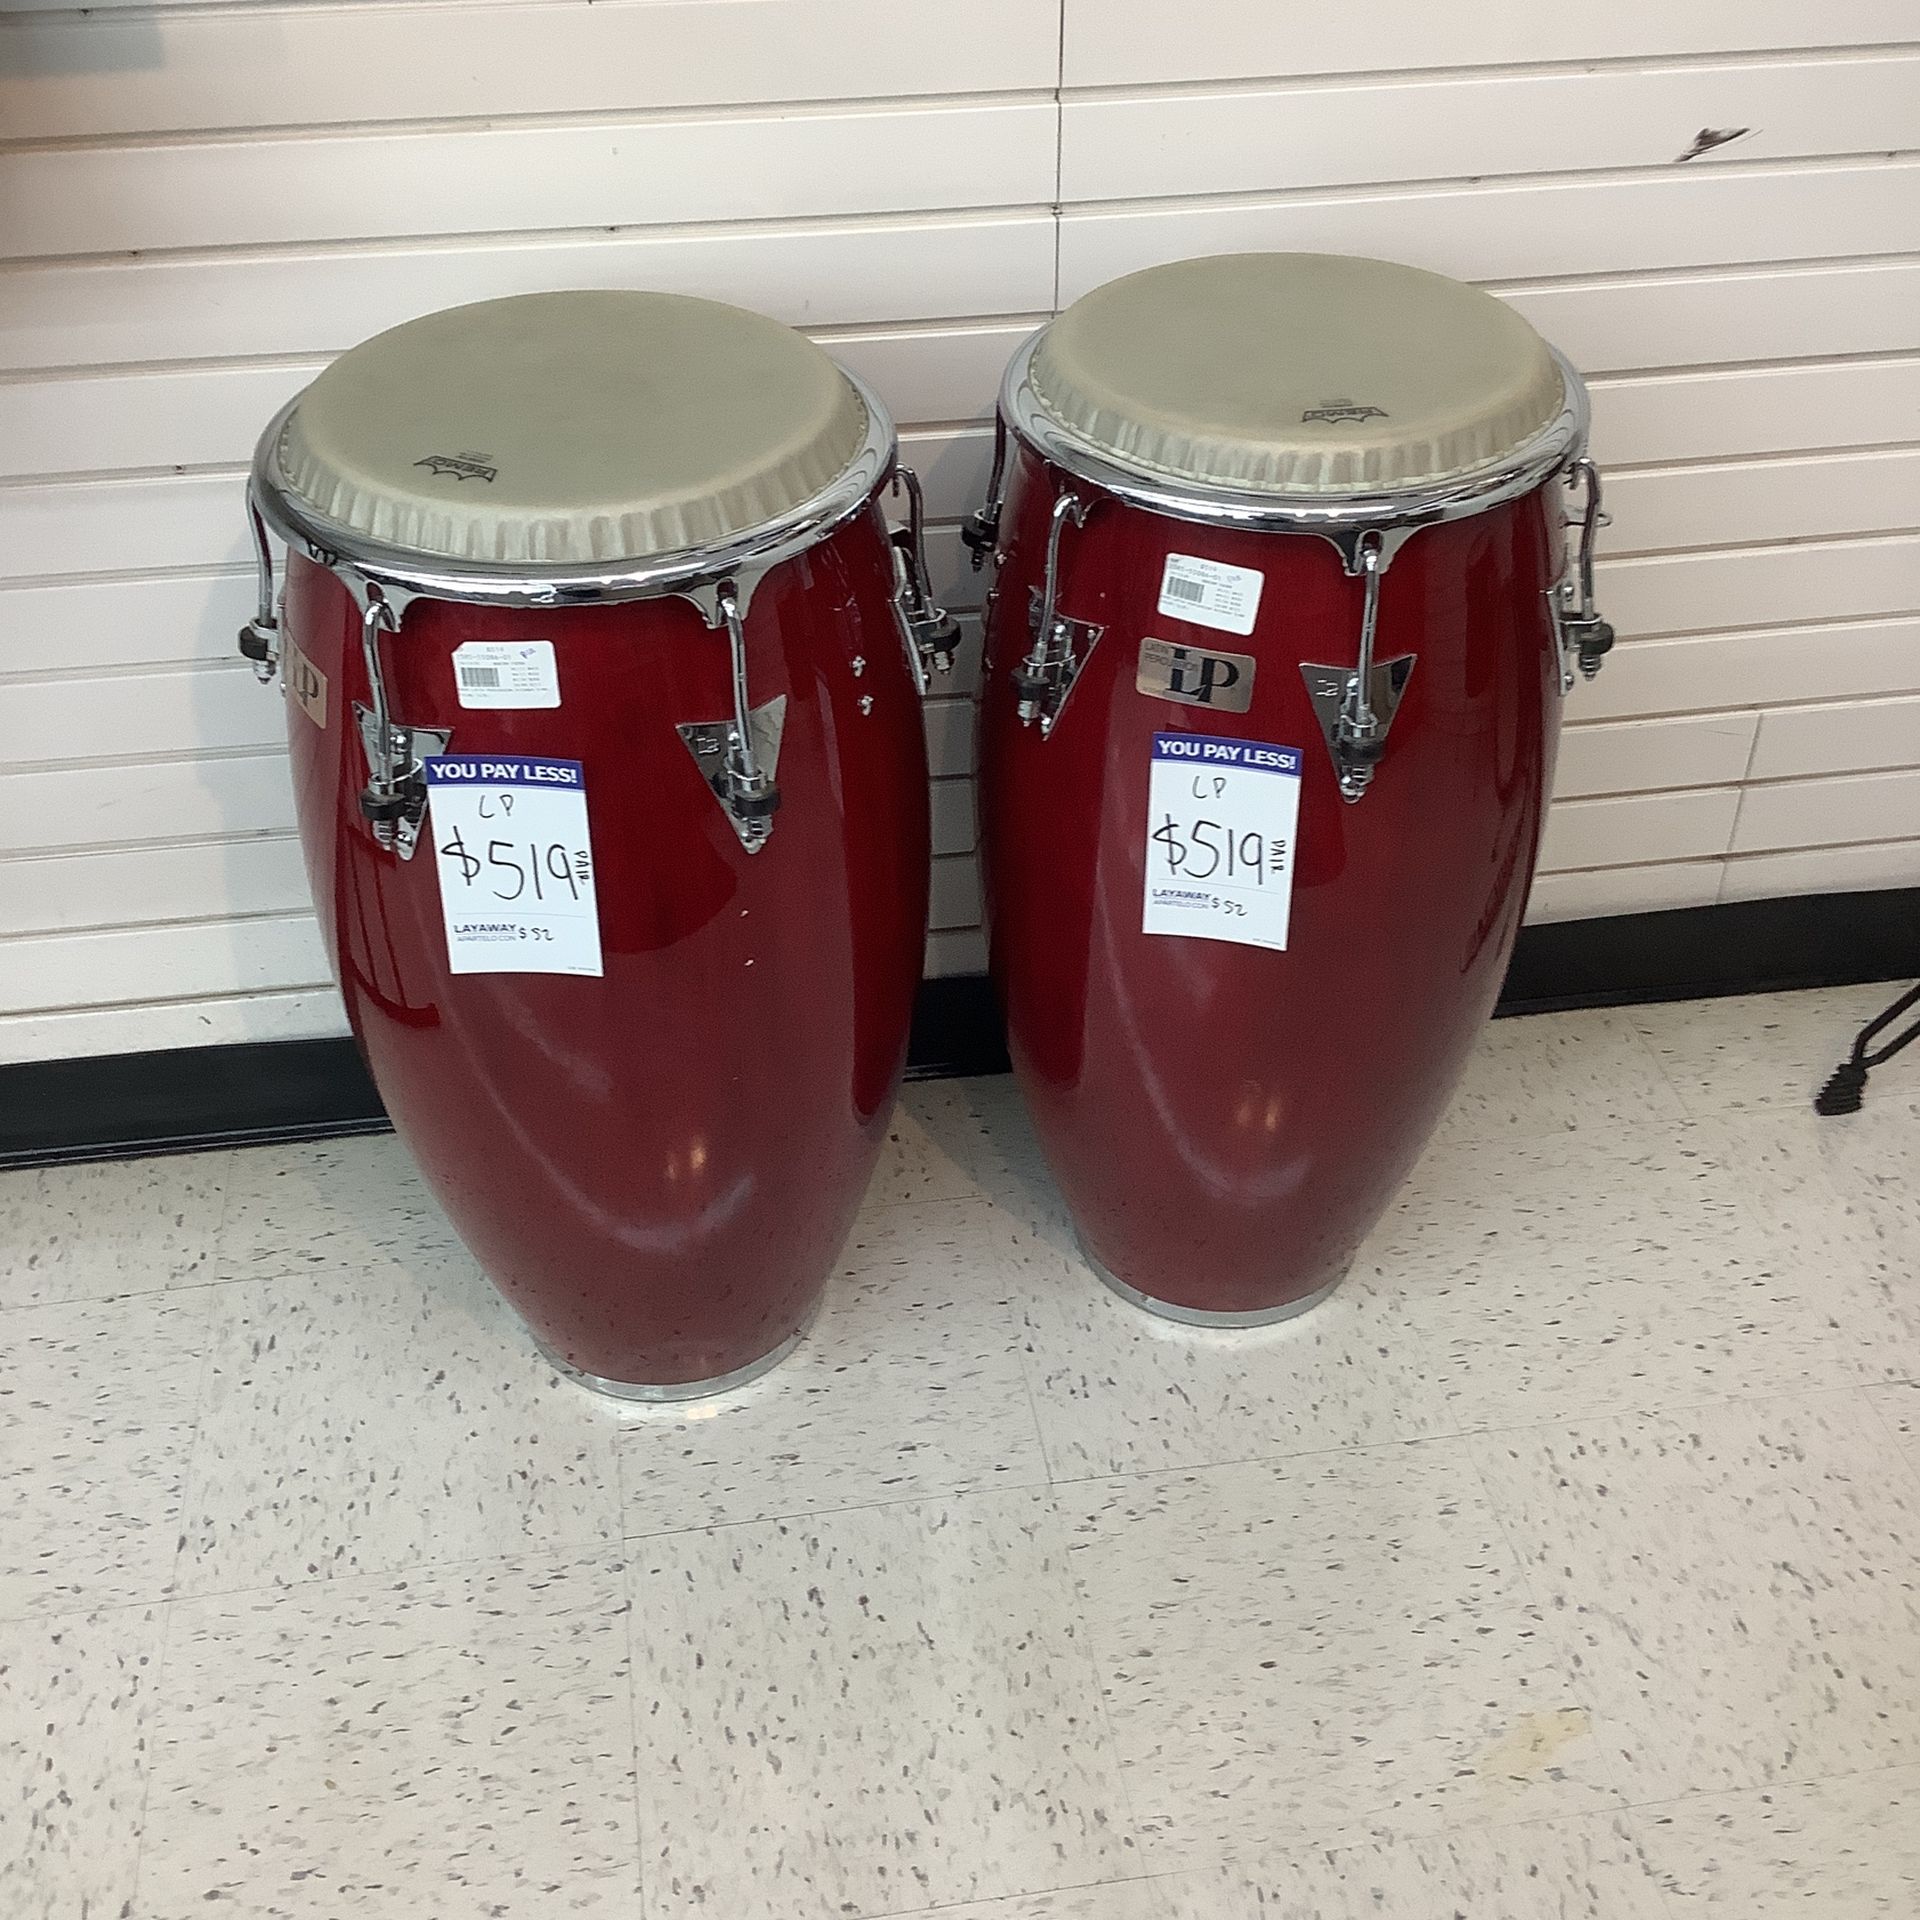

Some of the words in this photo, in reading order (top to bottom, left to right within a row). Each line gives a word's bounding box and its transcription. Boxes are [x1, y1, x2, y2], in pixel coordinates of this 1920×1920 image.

[1165, 646, 1239, 704] LP
[1158, 740, 1200, 757] YOU
[1203, 743, 1241, 761] PAY
[1244, 749, 1296, 769] LESS!
[431, 764, 477, 779] YOU
[481, 764, 520, 779] PAY
[523, 765, 577, 783] LESS!
[1192, 776, 1227, 799] LP
[479, 794, 514, 818] LP
[1152, 813, 1264, 885] $519
[440, 825, 579, 900] $519
[1152, 888, 1212, 901] LAYAWAY
[453, 924, 517, 934] LAYAWAY
